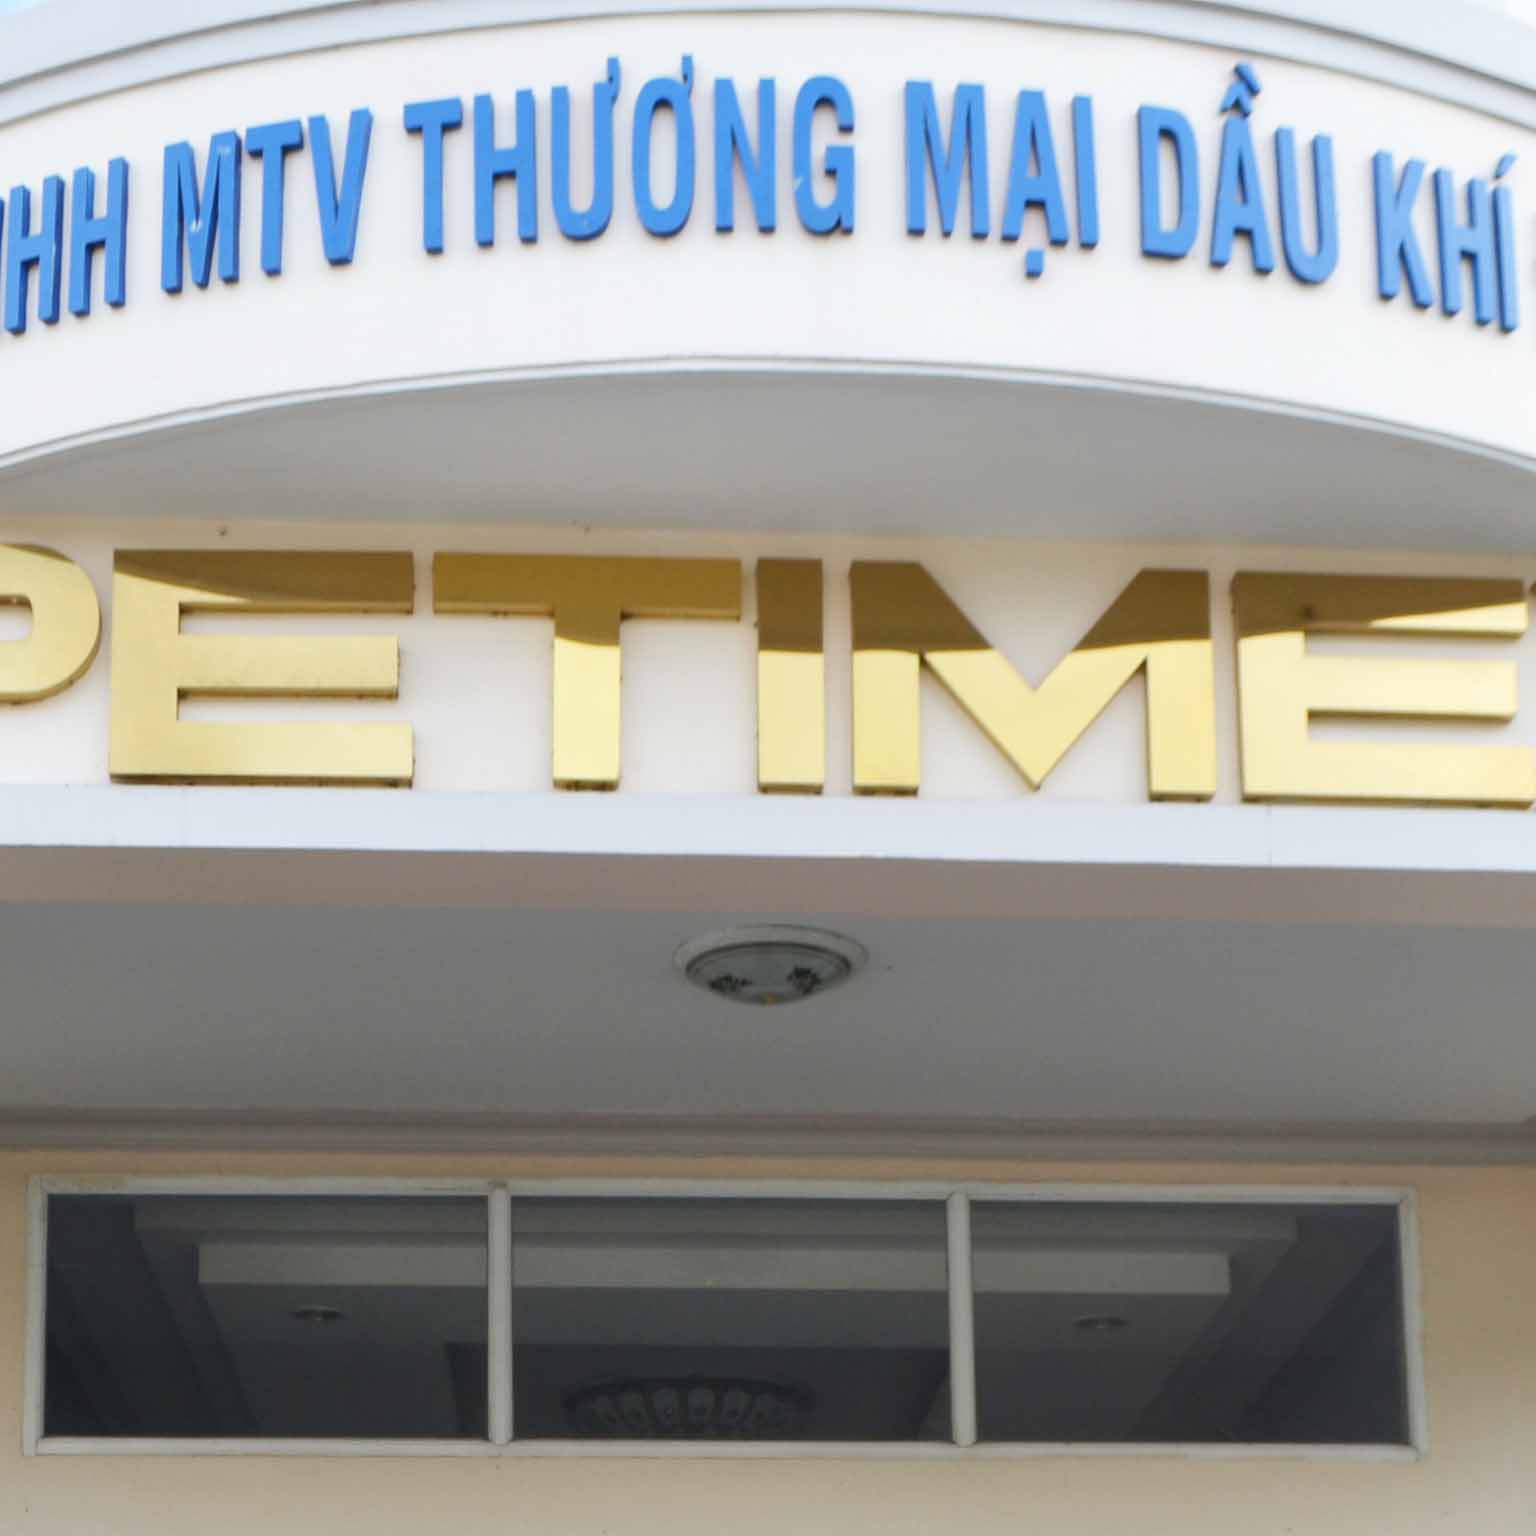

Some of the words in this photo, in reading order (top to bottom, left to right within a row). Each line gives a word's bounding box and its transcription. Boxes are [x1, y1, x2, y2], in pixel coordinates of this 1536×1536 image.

[159, 106, 375, 293] MTV
[402, 53, 857, 253] THƯƠNG
[903, 79, 1101, 278] MẠI
[1137, 62, 1340, 285] DẦU
[1371, 152, 1520, 333] KHÍ
